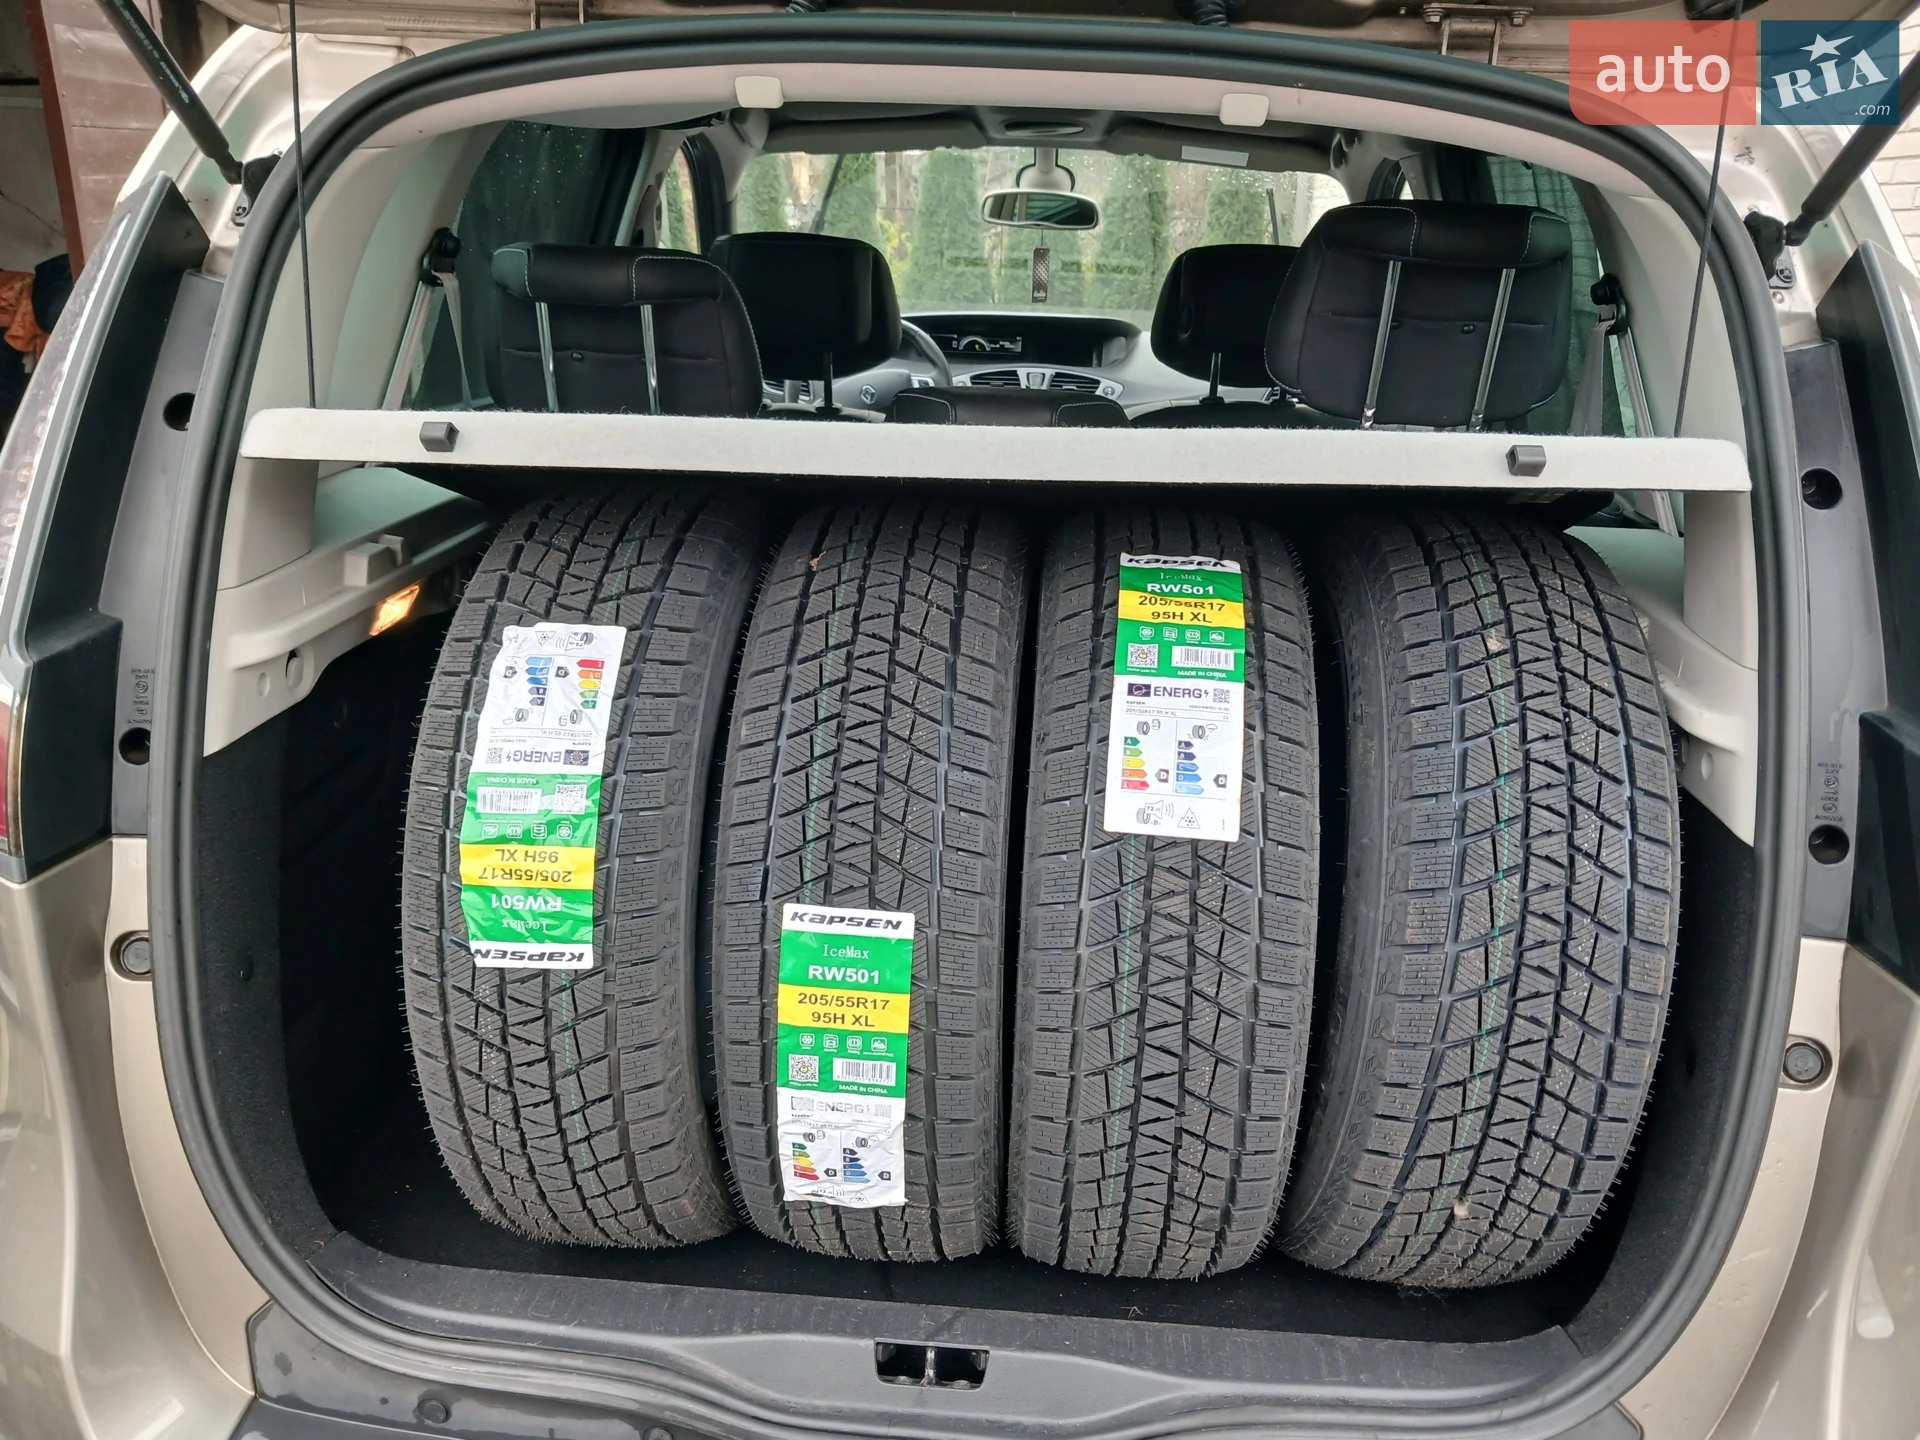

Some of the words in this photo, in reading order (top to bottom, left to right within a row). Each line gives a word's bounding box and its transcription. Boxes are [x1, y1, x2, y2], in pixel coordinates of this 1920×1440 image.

[1147, 583, 1214, 595] RW501
[1138, 595, 1225, 611] 205/55R17
[1151, 611, 1184, 620] 95H
[1190, 612, 1212, 623] XL
[1154, 686, 1202, 698] ENERG
[513, 750, 562, 763] ENERG
[495, 848, 518, 862] XL
[524, 850, 558, 863] 95H
[478, 867, 572, 882] 205/55R17
[491, 894, 562, 911] RW501
[823, 944, 869, 959] IceMax
[808, 965, 879, 984] RW501
[798, 993, 890, 1010] 205/55R17
[811, 1011, 845, 1024] 95H
[851, 1015, 875, 1027] XL
